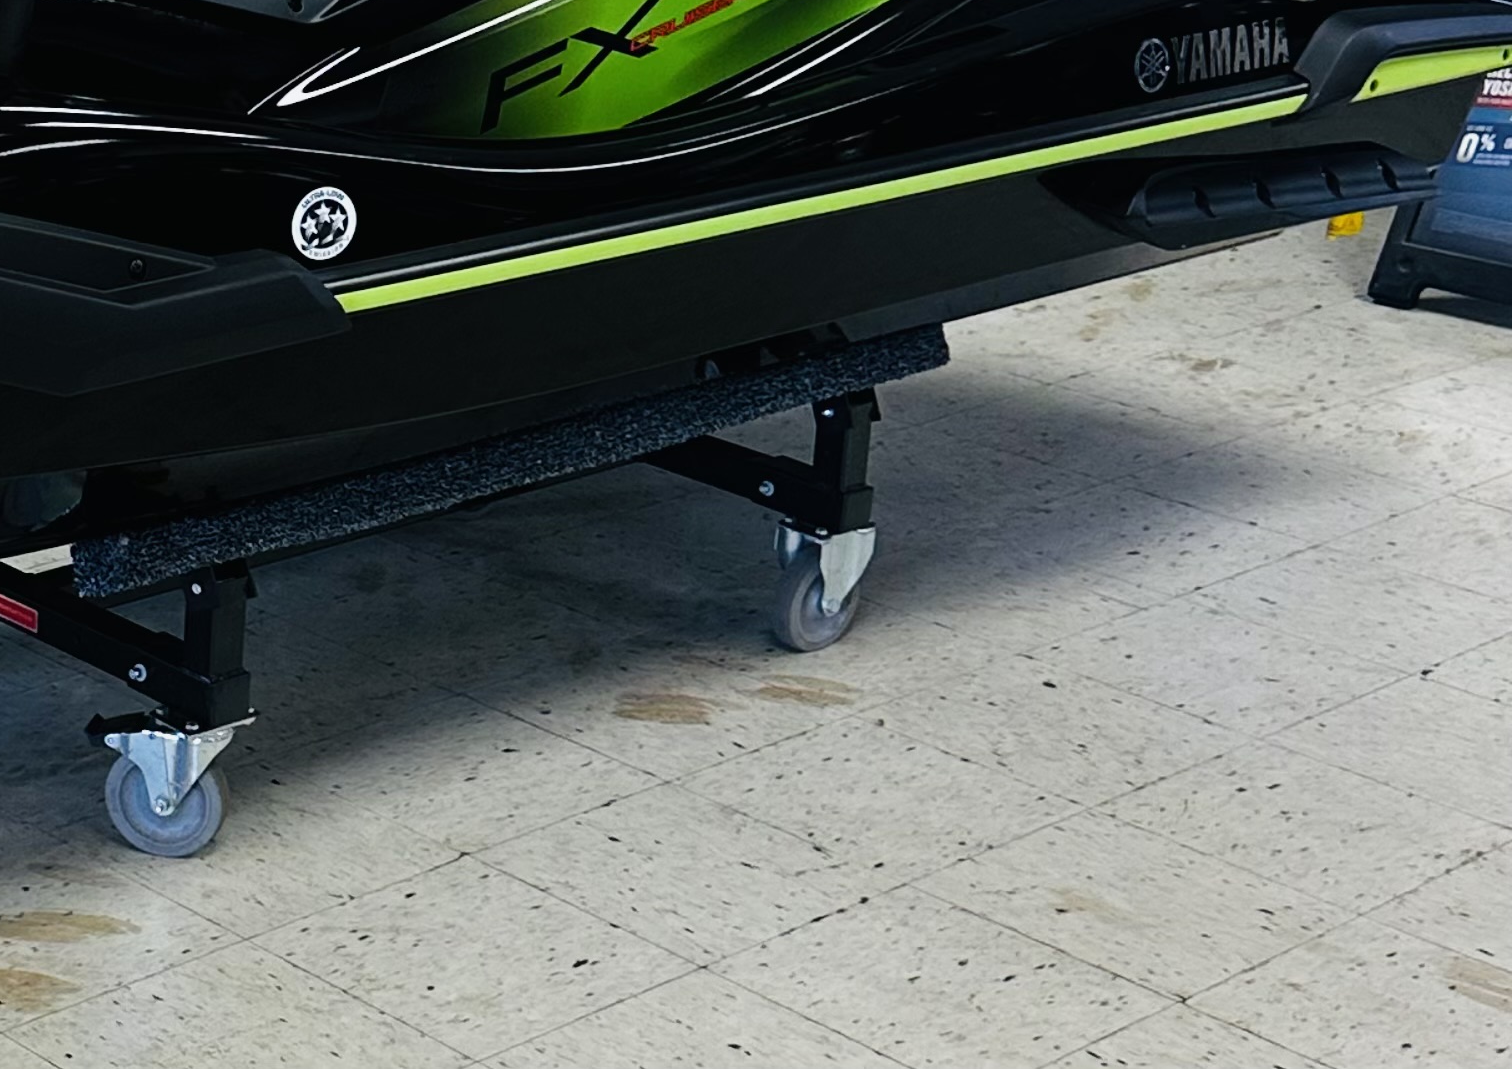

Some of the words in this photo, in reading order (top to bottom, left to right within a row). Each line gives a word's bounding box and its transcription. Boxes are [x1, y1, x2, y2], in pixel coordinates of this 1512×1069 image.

[1170, 17, 1289, 84] YAMAHA
[1482, 78, 1512, 97] YOS
[1456, 133, 1497, 163] 0%
